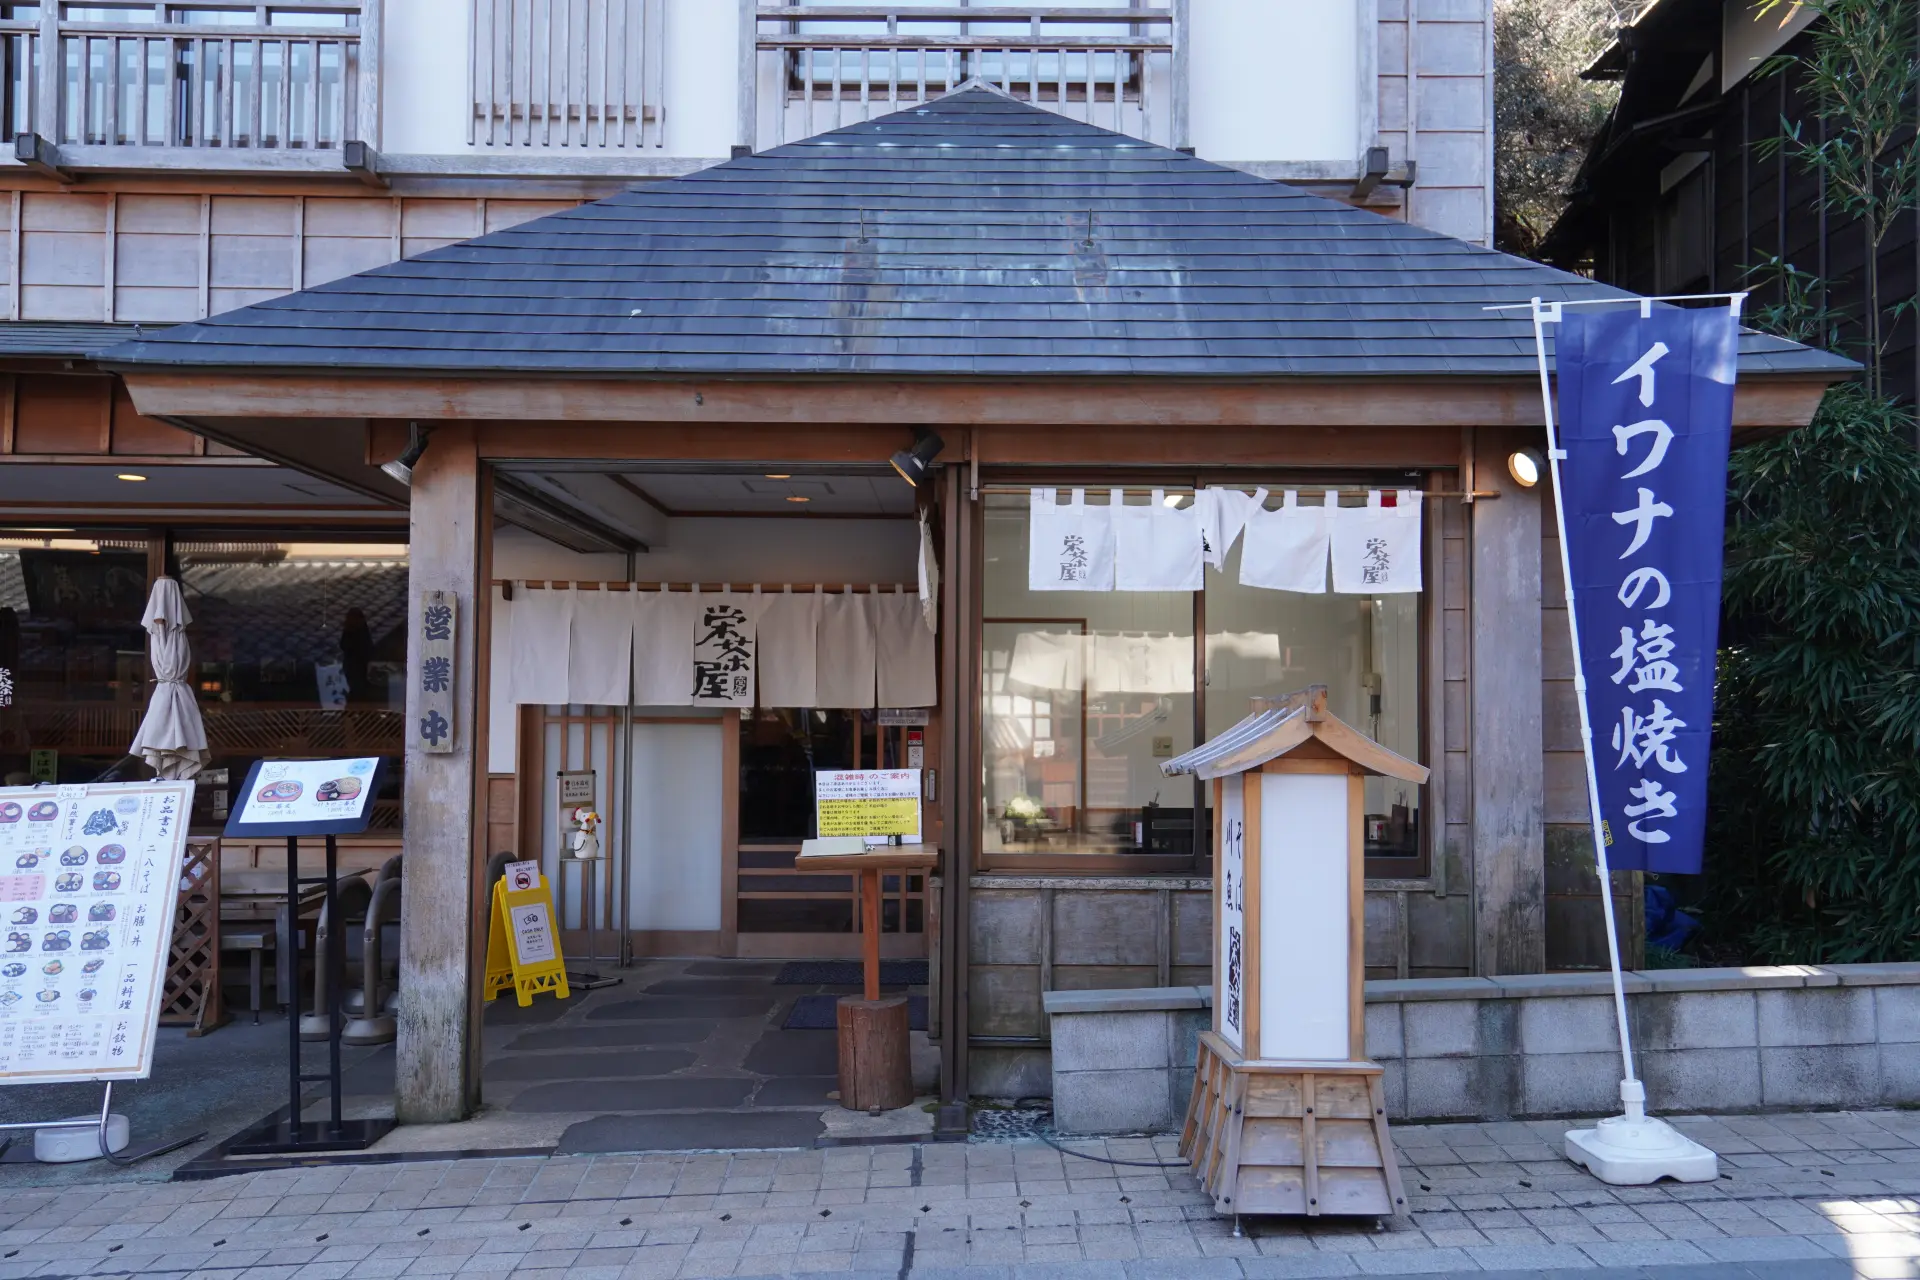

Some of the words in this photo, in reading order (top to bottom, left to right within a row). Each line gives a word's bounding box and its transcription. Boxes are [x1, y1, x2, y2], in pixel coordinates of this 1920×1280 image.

[1059, 534, 1088, 581] 栄茶屋
[1362, 537, 1391, 584] 栄茶屋
[1610, 341, 1687, 845] イワナの塩焼き
[691, 604, 753, 700] 栄茶屋
[420, 605, 452, 747] 営業中
[157, 795, 176, 837] お品書き
[139, 844, 156, 894] 二八そば
[118, 963, 138, 1010] 一品料理
[111, 1021, 129, 1057] お飲物
